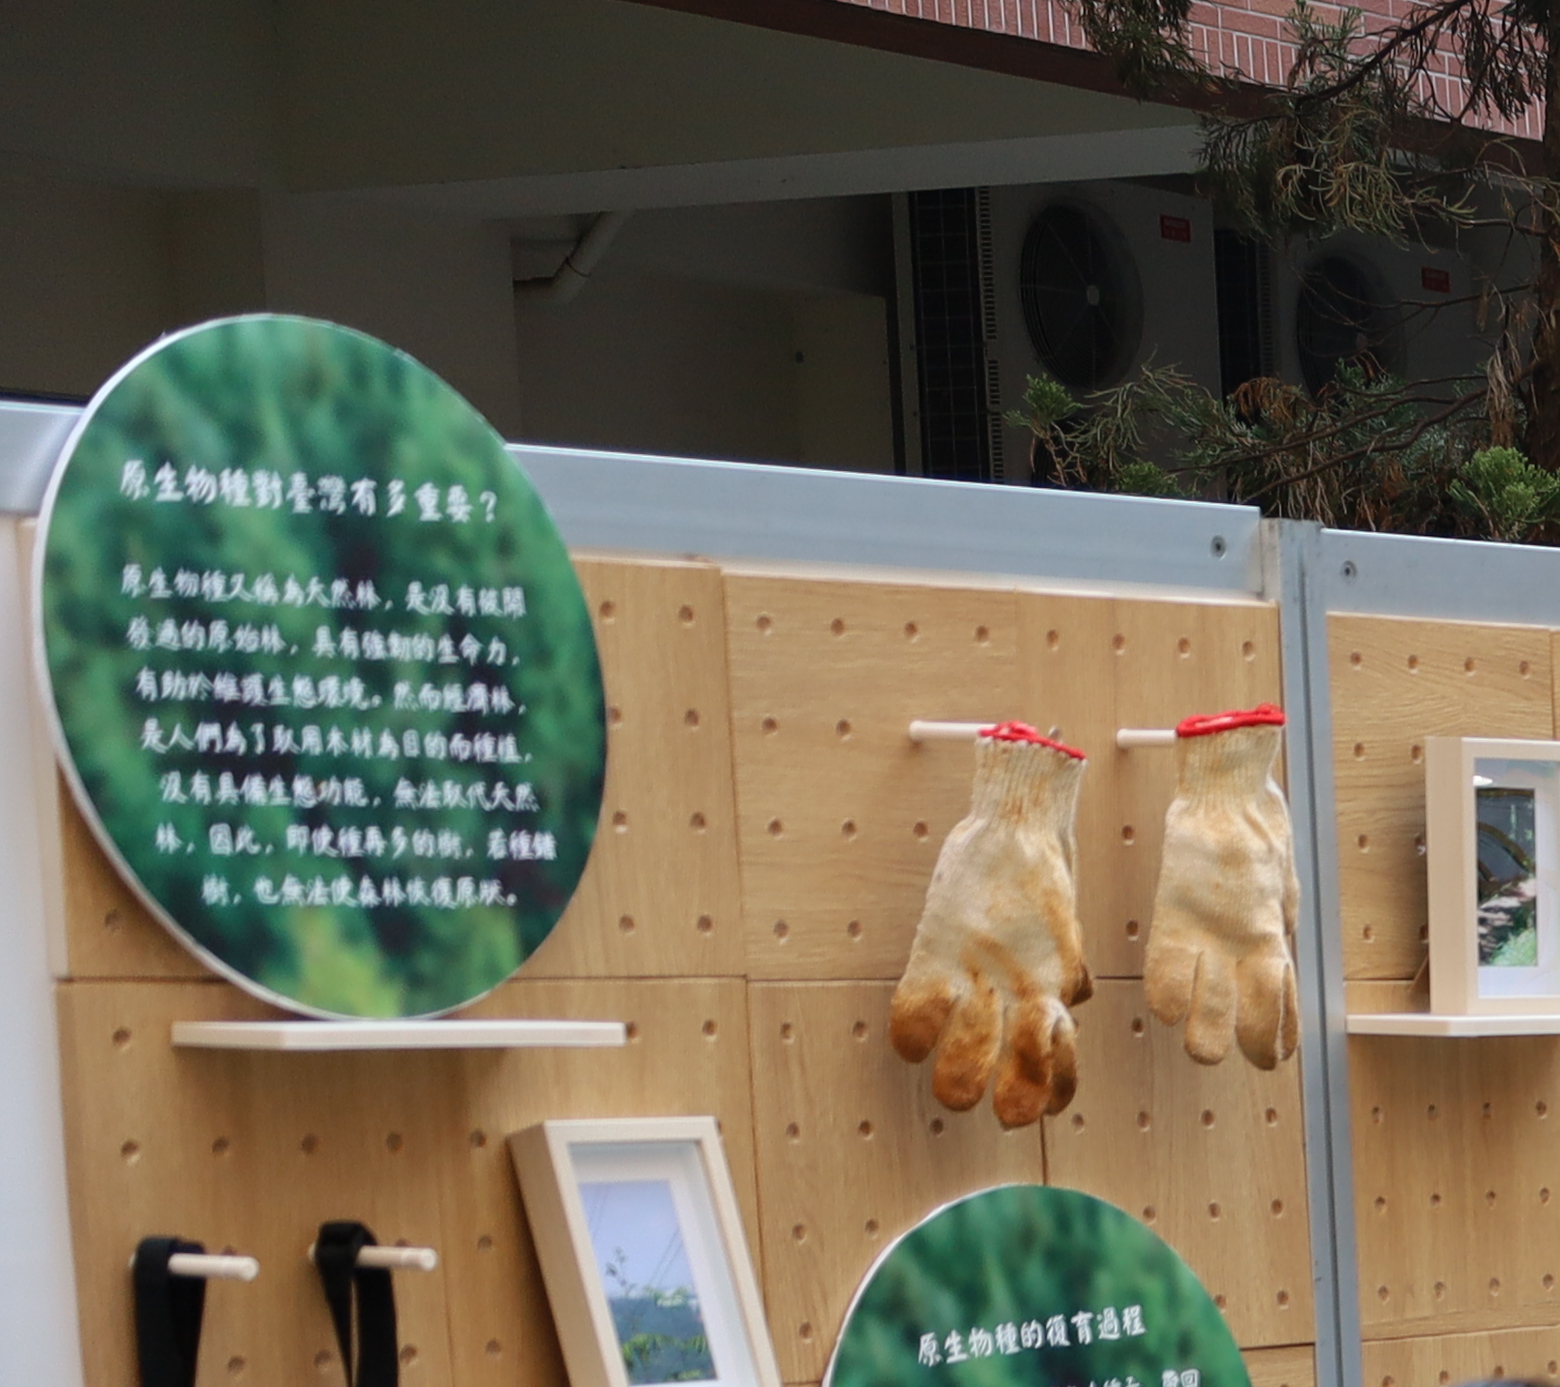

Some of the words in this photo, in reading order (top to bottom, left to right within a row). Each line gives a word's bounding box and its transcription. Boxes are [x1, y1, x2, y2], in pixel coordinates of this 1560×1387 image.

[918, 1303, 1147, 1368] 原生物種的復育過程
